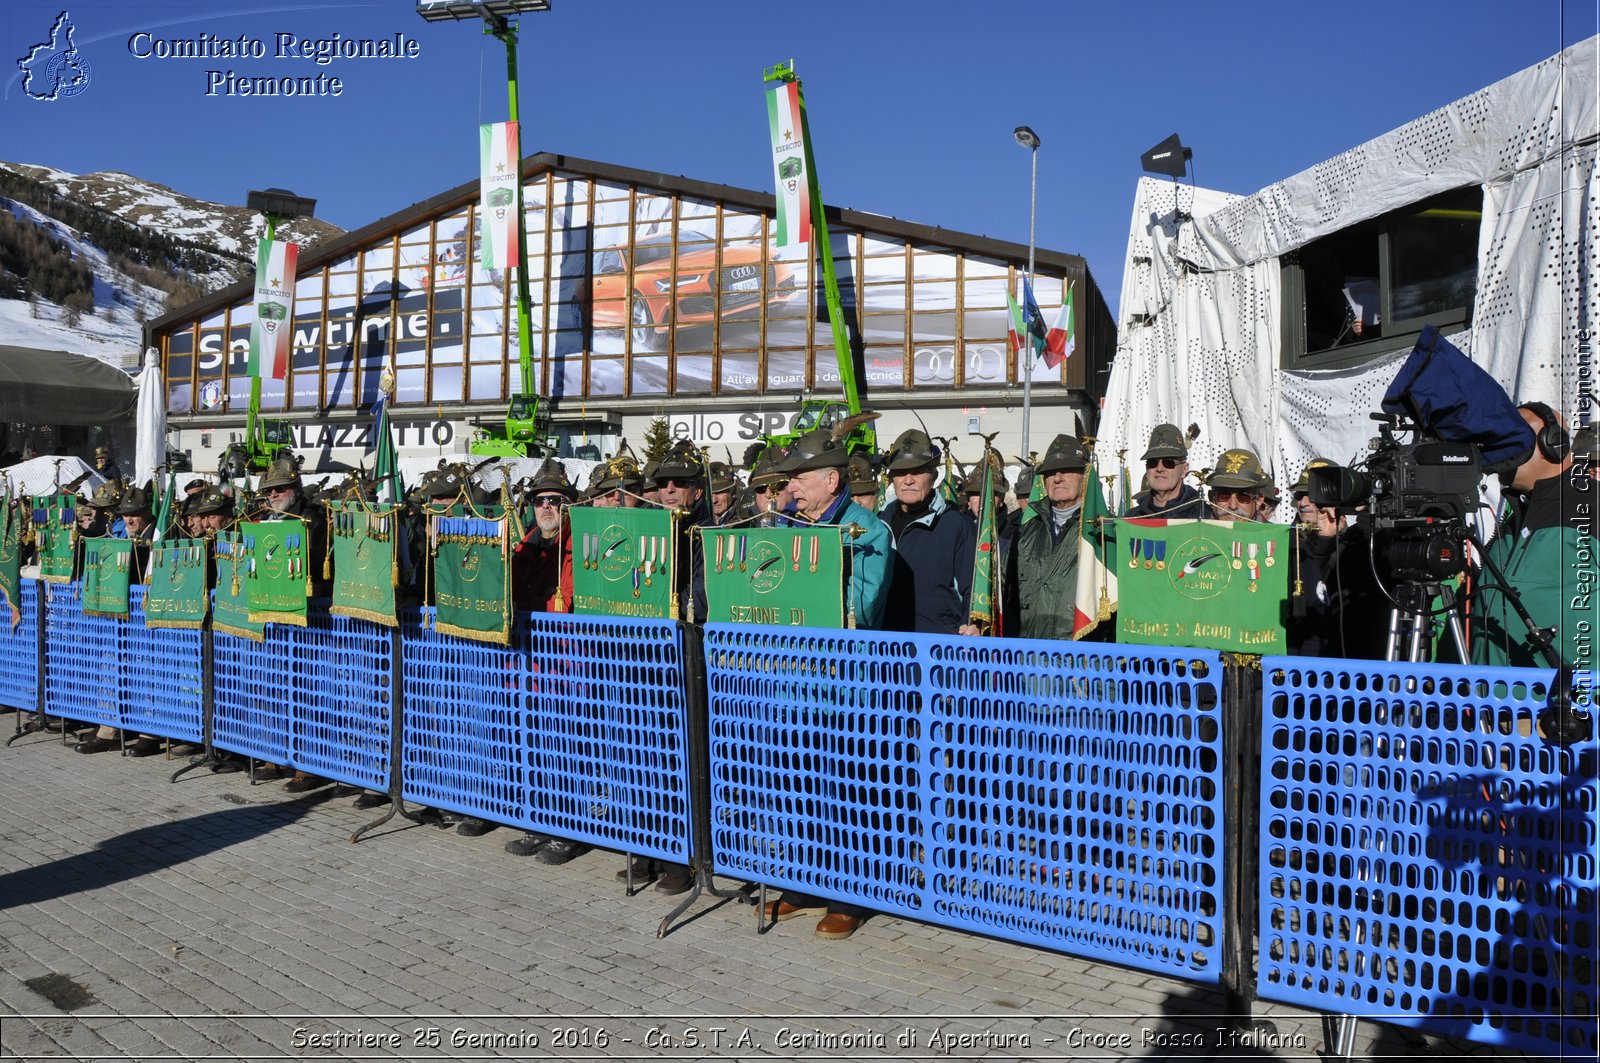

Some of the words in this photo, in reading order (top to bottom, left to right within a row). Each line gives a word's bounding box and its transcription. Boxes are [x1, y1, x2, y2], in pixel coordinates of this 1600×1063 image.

[776, 140, 802, 153] ESERCITO
[485, 173, 516, 183] ESERCITO
[258, 287, 291, 298] ESERCITO
[199, 310, 450, 369] Snwtime.
[872, 358, 903, 368] Audi
[726, 373, 819, 385] All'avnguarda
[864, 371, 903, 381] ecnica
[667, 414, 724, 440] ello
[289, 420, 454, 449] LAZZTTO
[475, 599, 505, 613] GENOV
[730, 605, 780, 625] SEZIONE
[790, 607, 805, 626] DI
[1193, 622, 1231, 639] ACQUI
[1239, 628, 1278, 645] TERME
